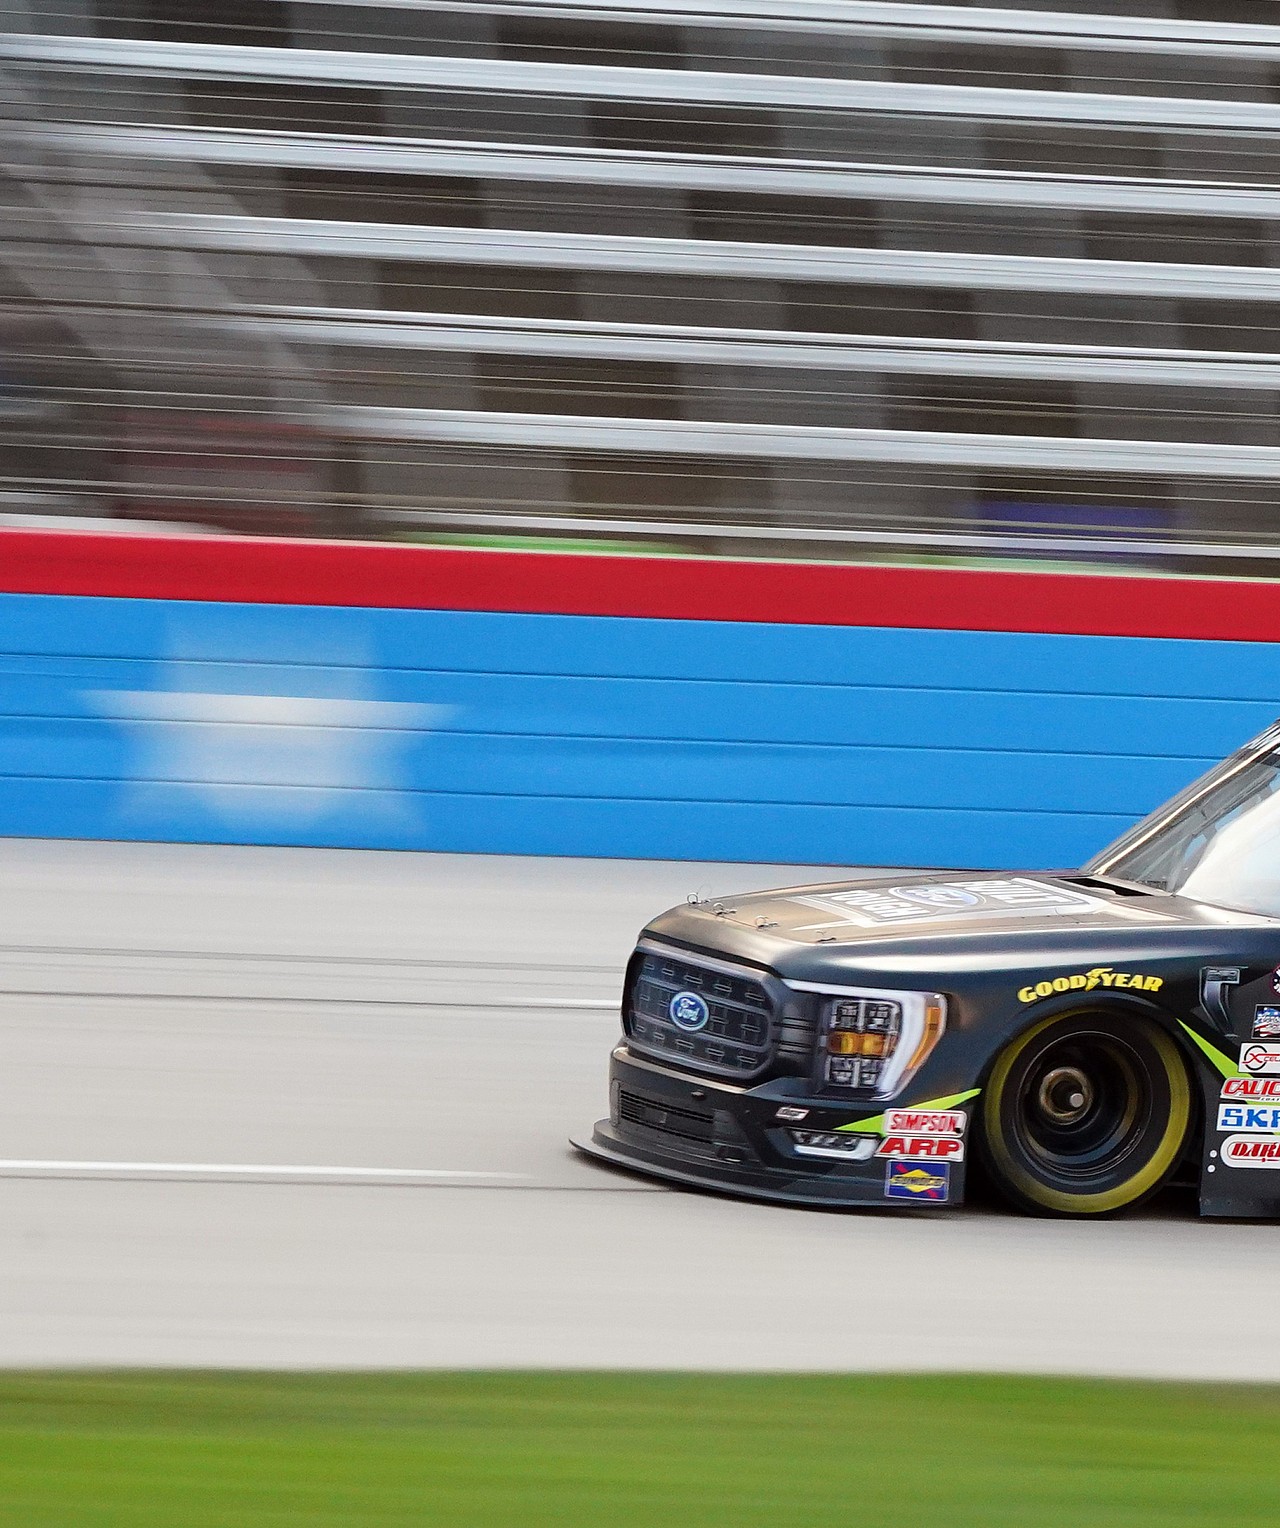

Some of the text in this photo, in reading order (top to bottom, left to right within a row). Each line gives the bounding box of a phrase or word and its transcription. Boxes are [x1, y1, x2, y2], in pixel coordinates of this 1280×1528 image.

[1017, 968, 1164, 1003] GOODYEAR
[676, 997, 701, 1022] Ford
[889, 1113, 959, 1133] SIMPSON
[879, 1136, 961, 1156] ARP
